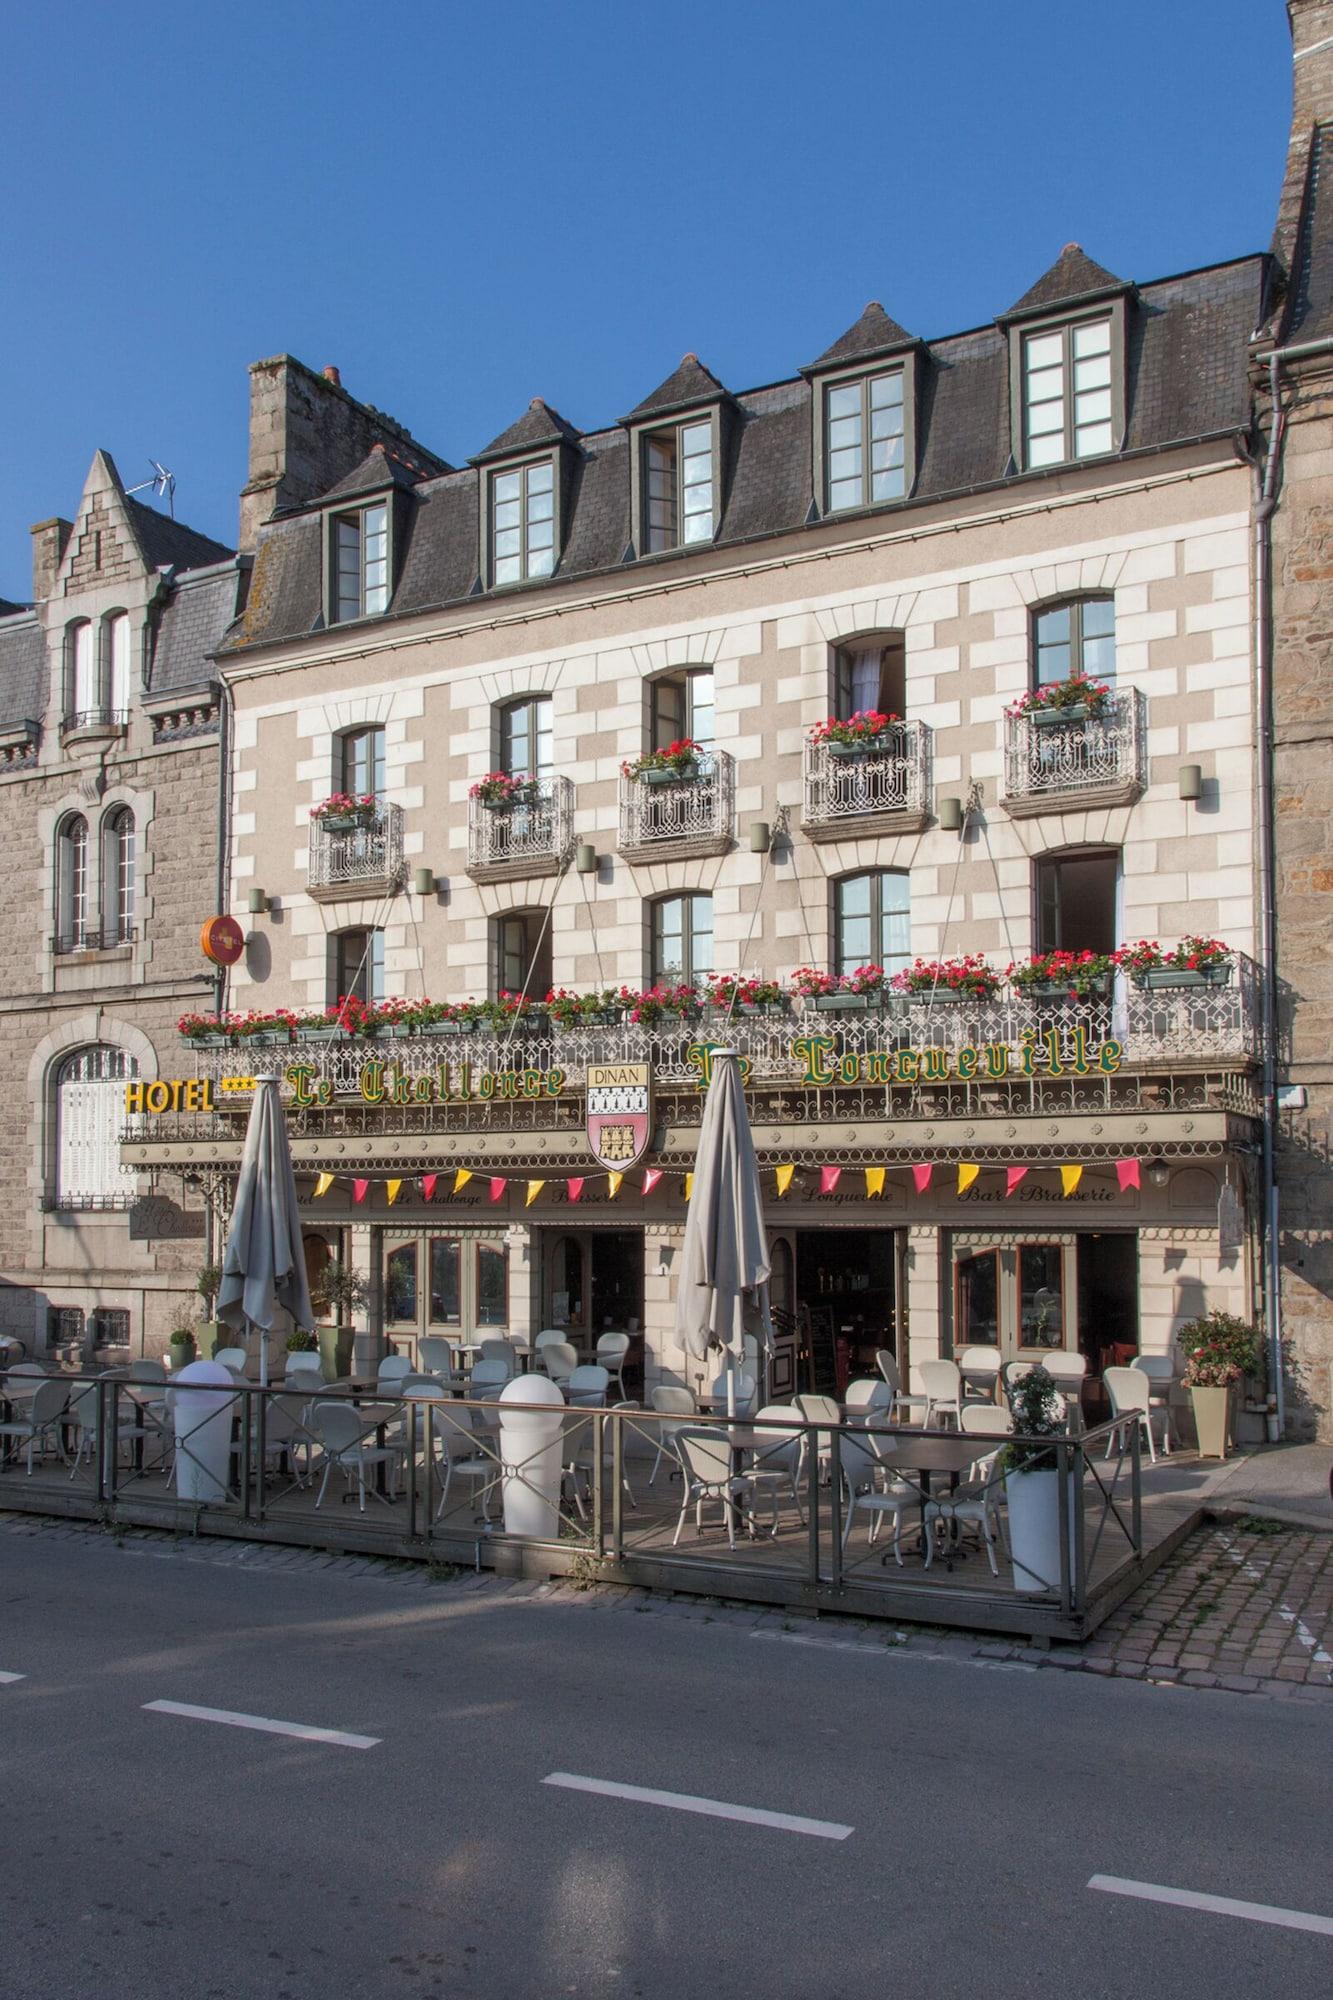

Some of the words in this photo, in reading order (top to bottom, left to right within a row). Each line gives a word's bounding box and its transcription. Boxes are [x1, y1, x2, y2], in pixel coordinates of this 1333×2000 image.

[286, 1063, 334, 1107] Le
[594, 1068, 639, 1085] DINAN
[126, 1078, 216, 1113] HOTEL
[957, 1185, 1003, 1202] Bar
[1019, 1184, 1116, 1202] Brasserie
